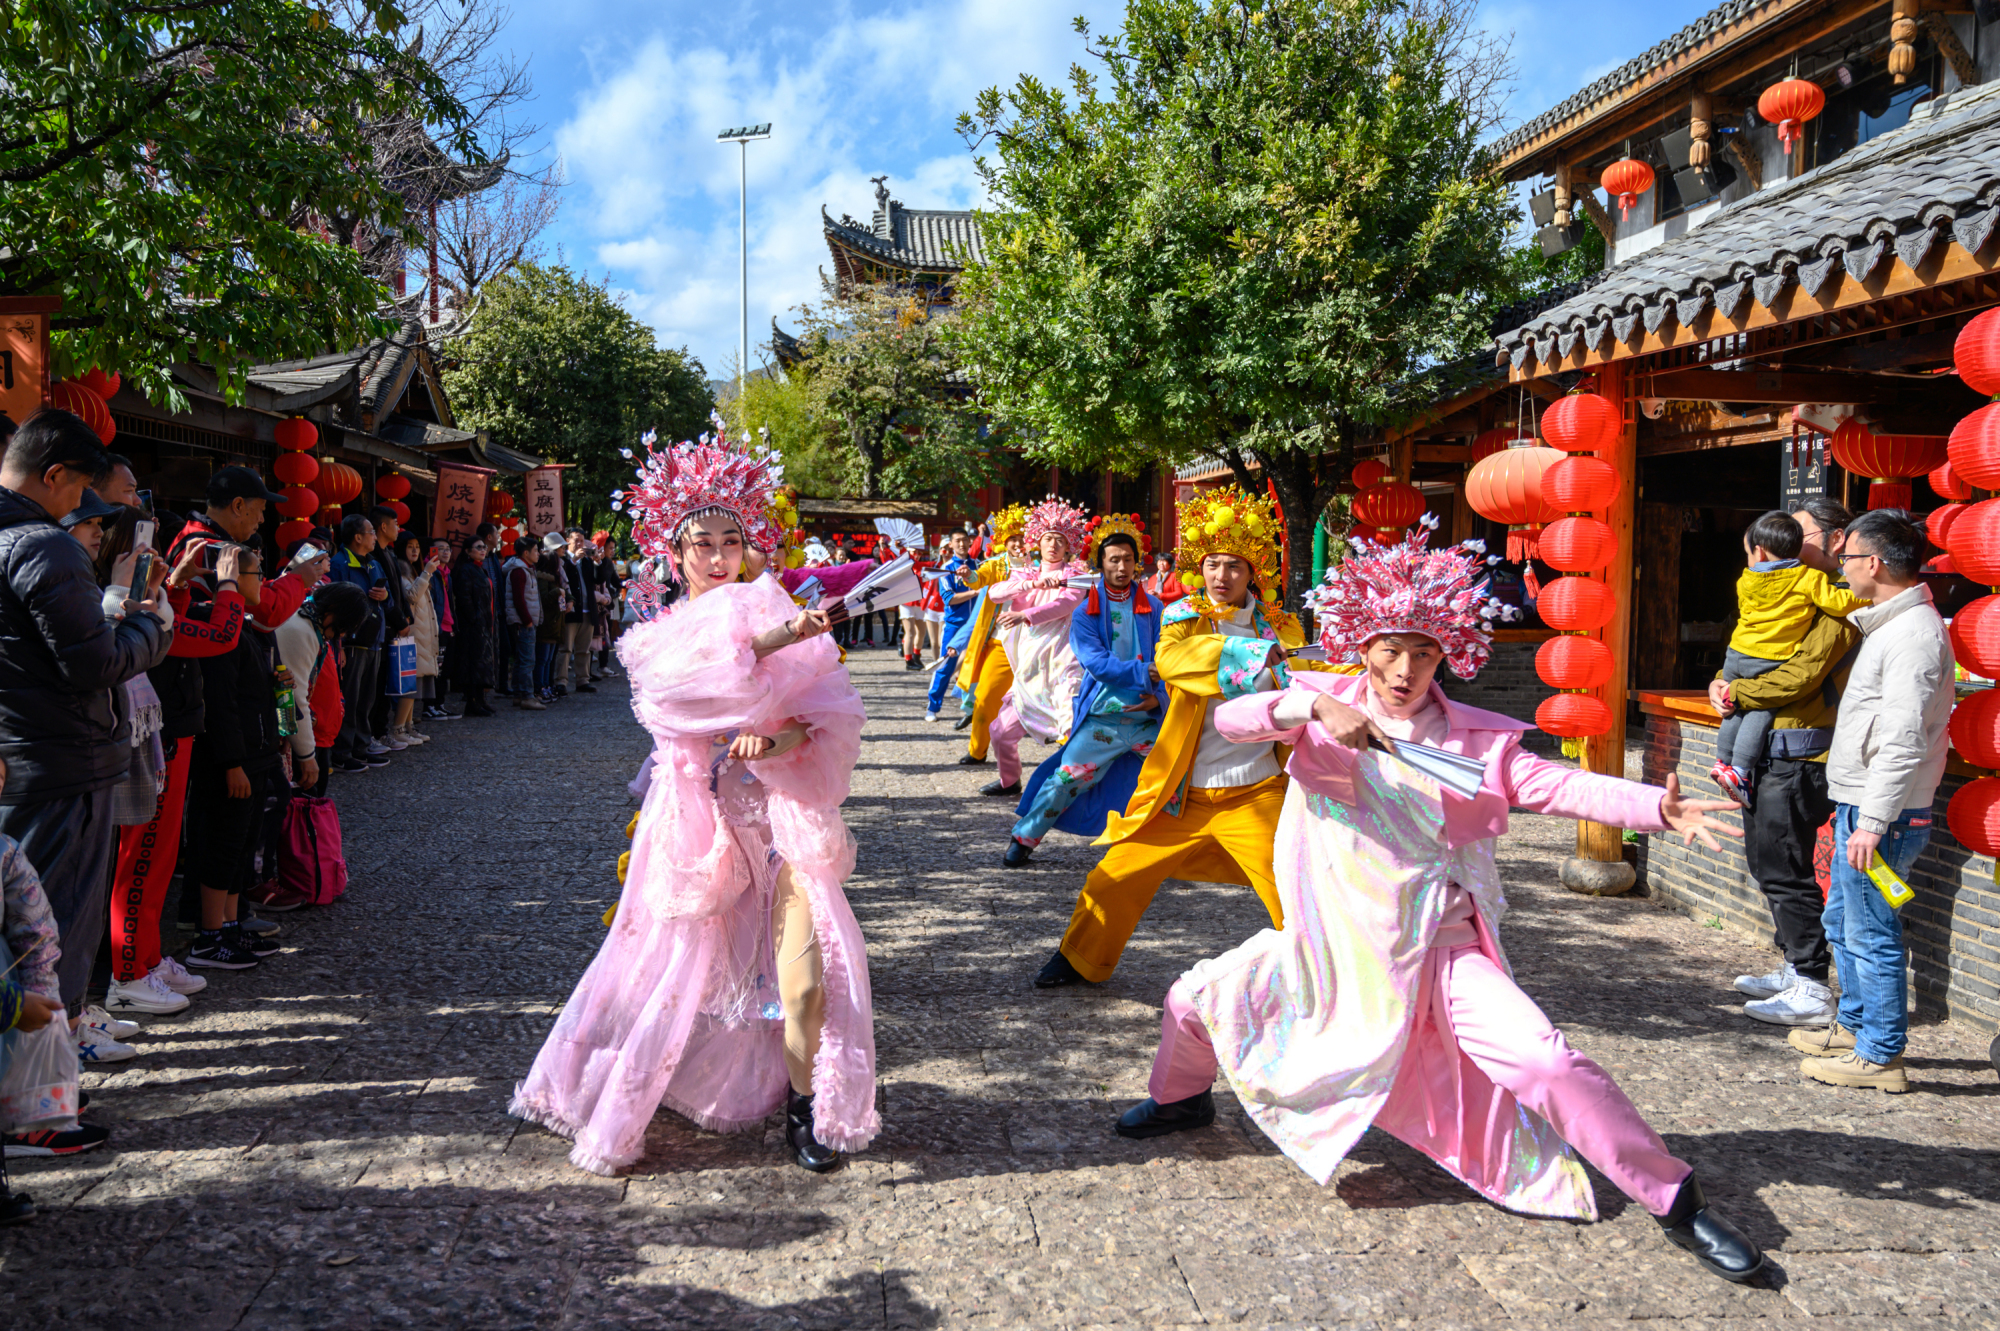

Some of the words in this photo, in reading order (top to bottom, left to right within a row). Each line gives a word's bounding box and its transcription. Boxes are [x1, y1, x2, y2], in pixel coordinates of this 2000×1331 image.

[1785, 438, 1824, 453] 游休区
[445, 482, 475, 548] 烧烤店
[534, 479, 555, 525] 豆腐坊
